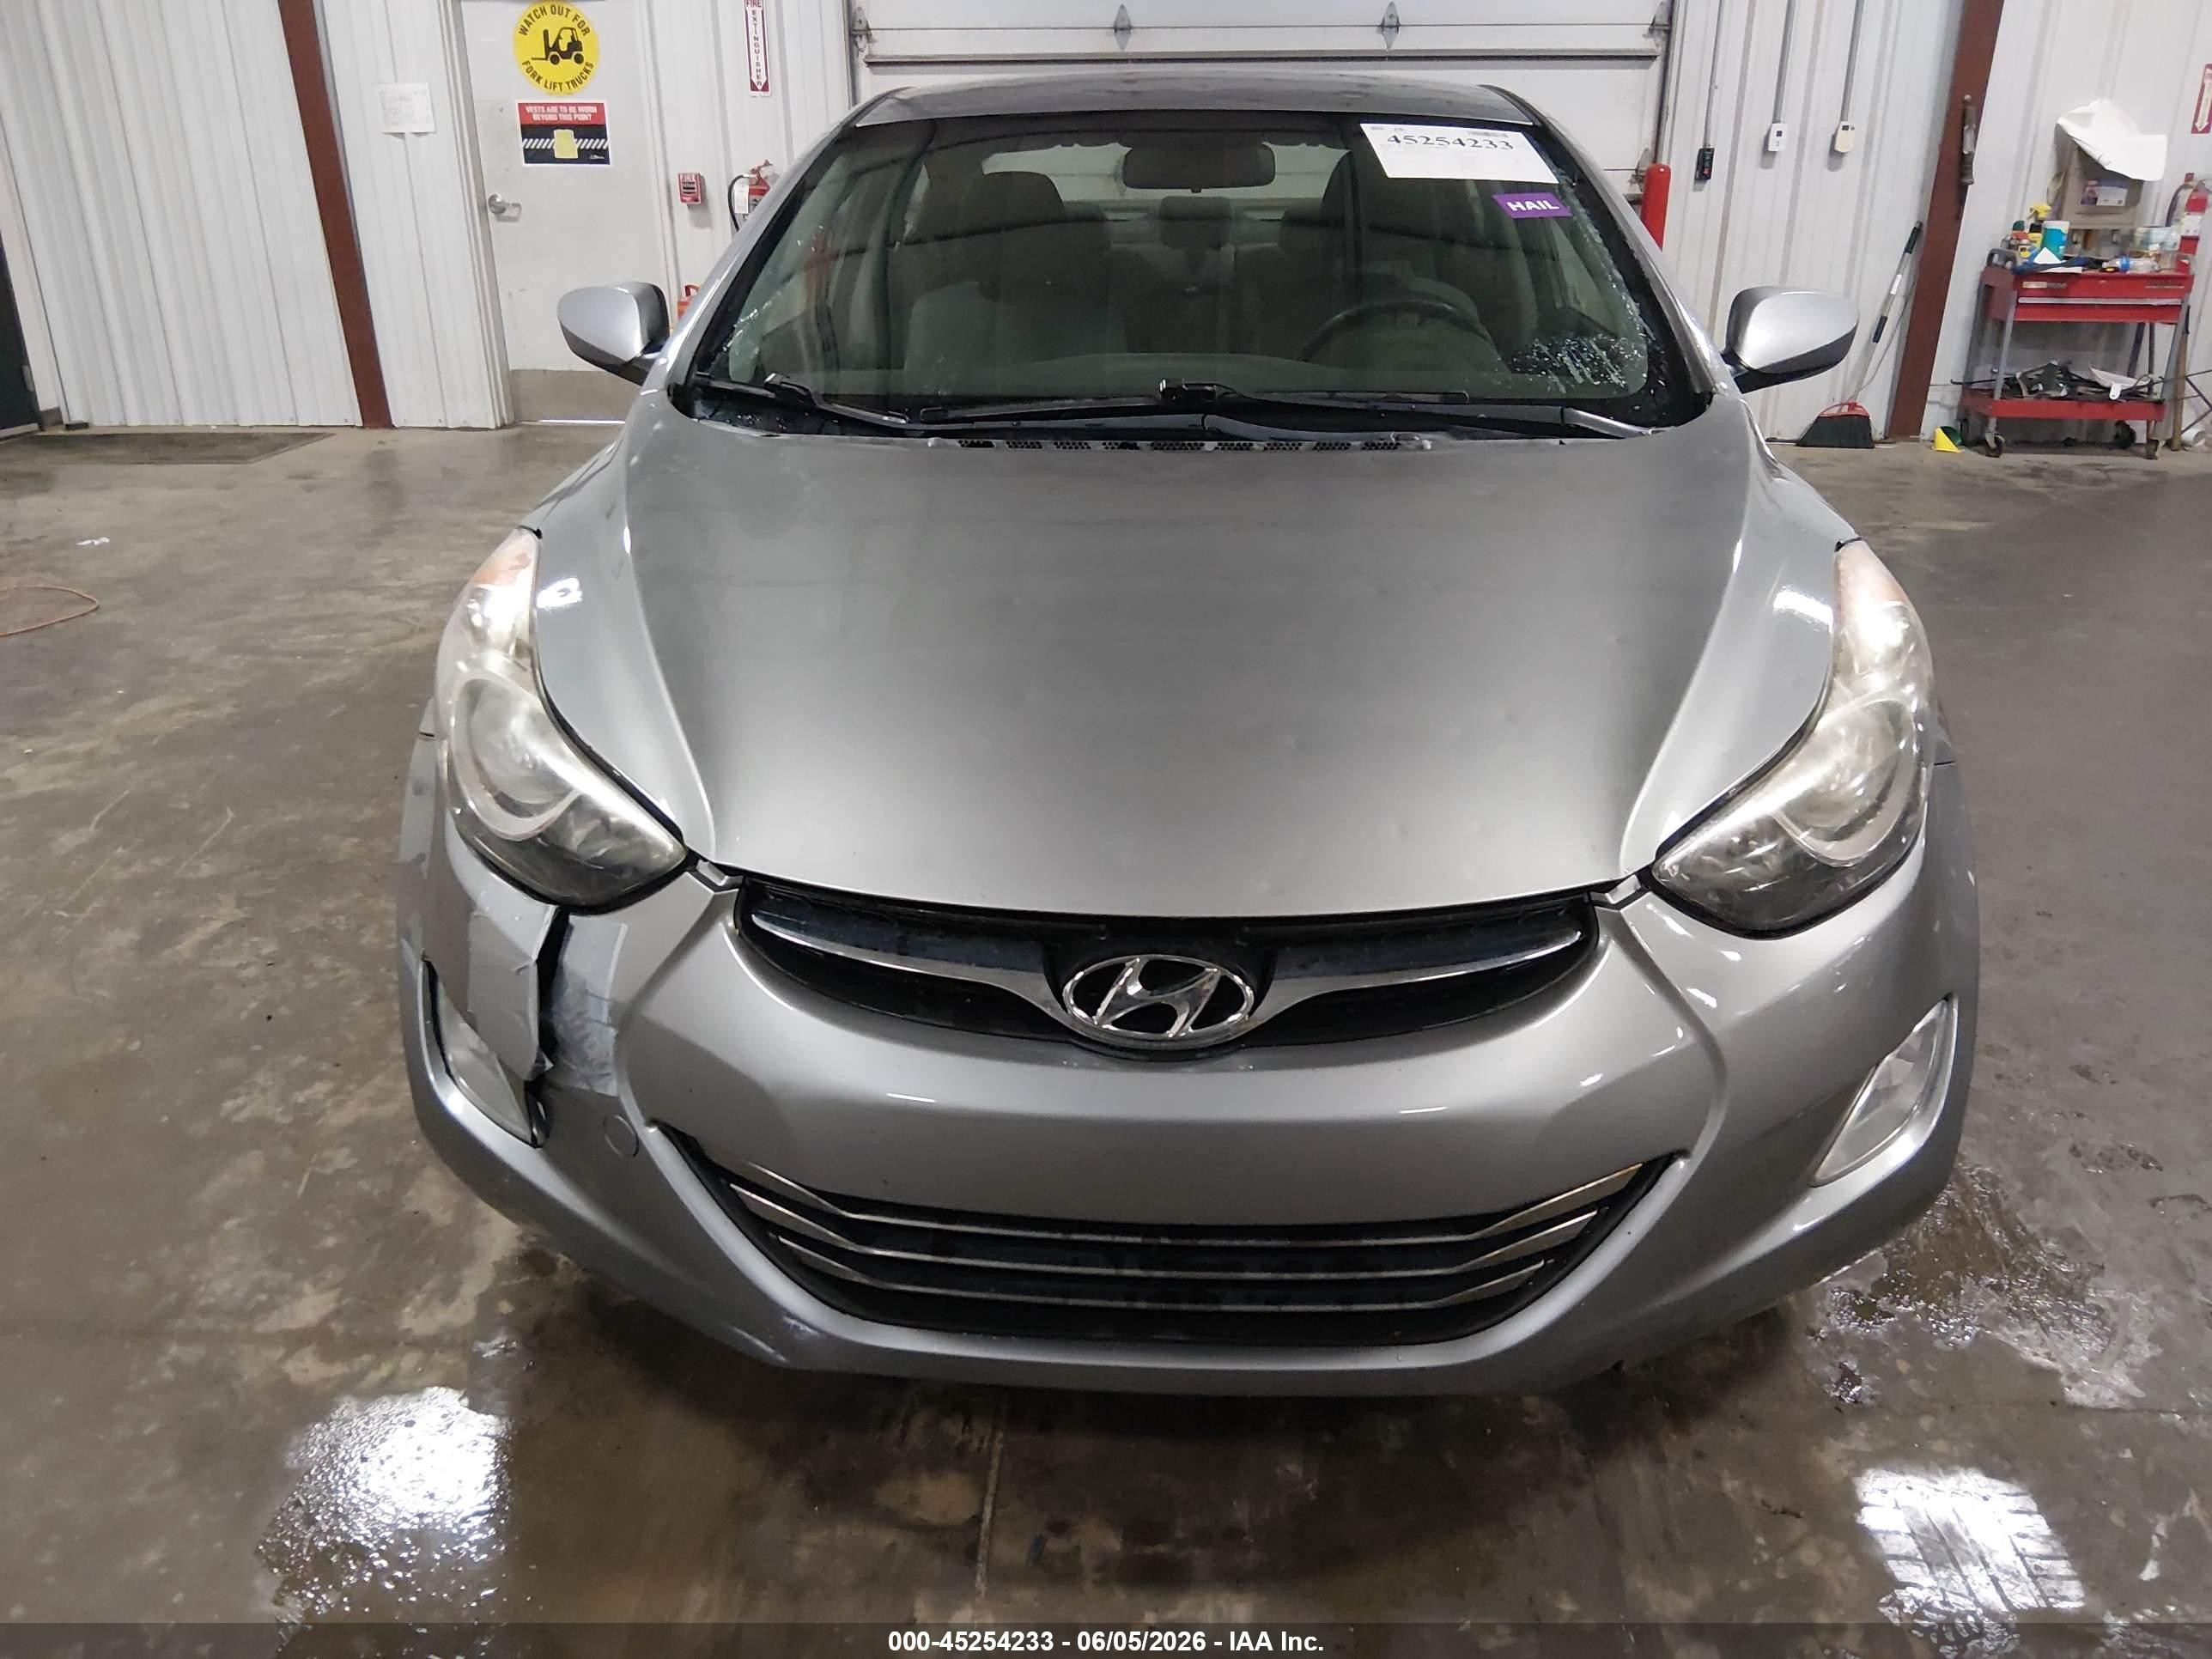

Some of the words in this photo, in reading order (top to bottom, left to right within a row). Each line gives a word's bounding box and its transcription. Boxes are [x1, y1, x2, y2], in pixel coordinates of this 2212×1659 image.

[518, 6, 548, 36] WATCH
[550, 3, 571, 18] OUT
[572, 14, 591, 36] FOR
[751, 9, 763, 86] EXTINGUISHER
[522, 60, 543, 84] FORK
[544, 79, 563, 92] LIFT
[565, 61, 594, 91] TRUCKS
[1387, 135, 1514, 150] 45254233
[1506, 199, 1560, 211] HAIL
